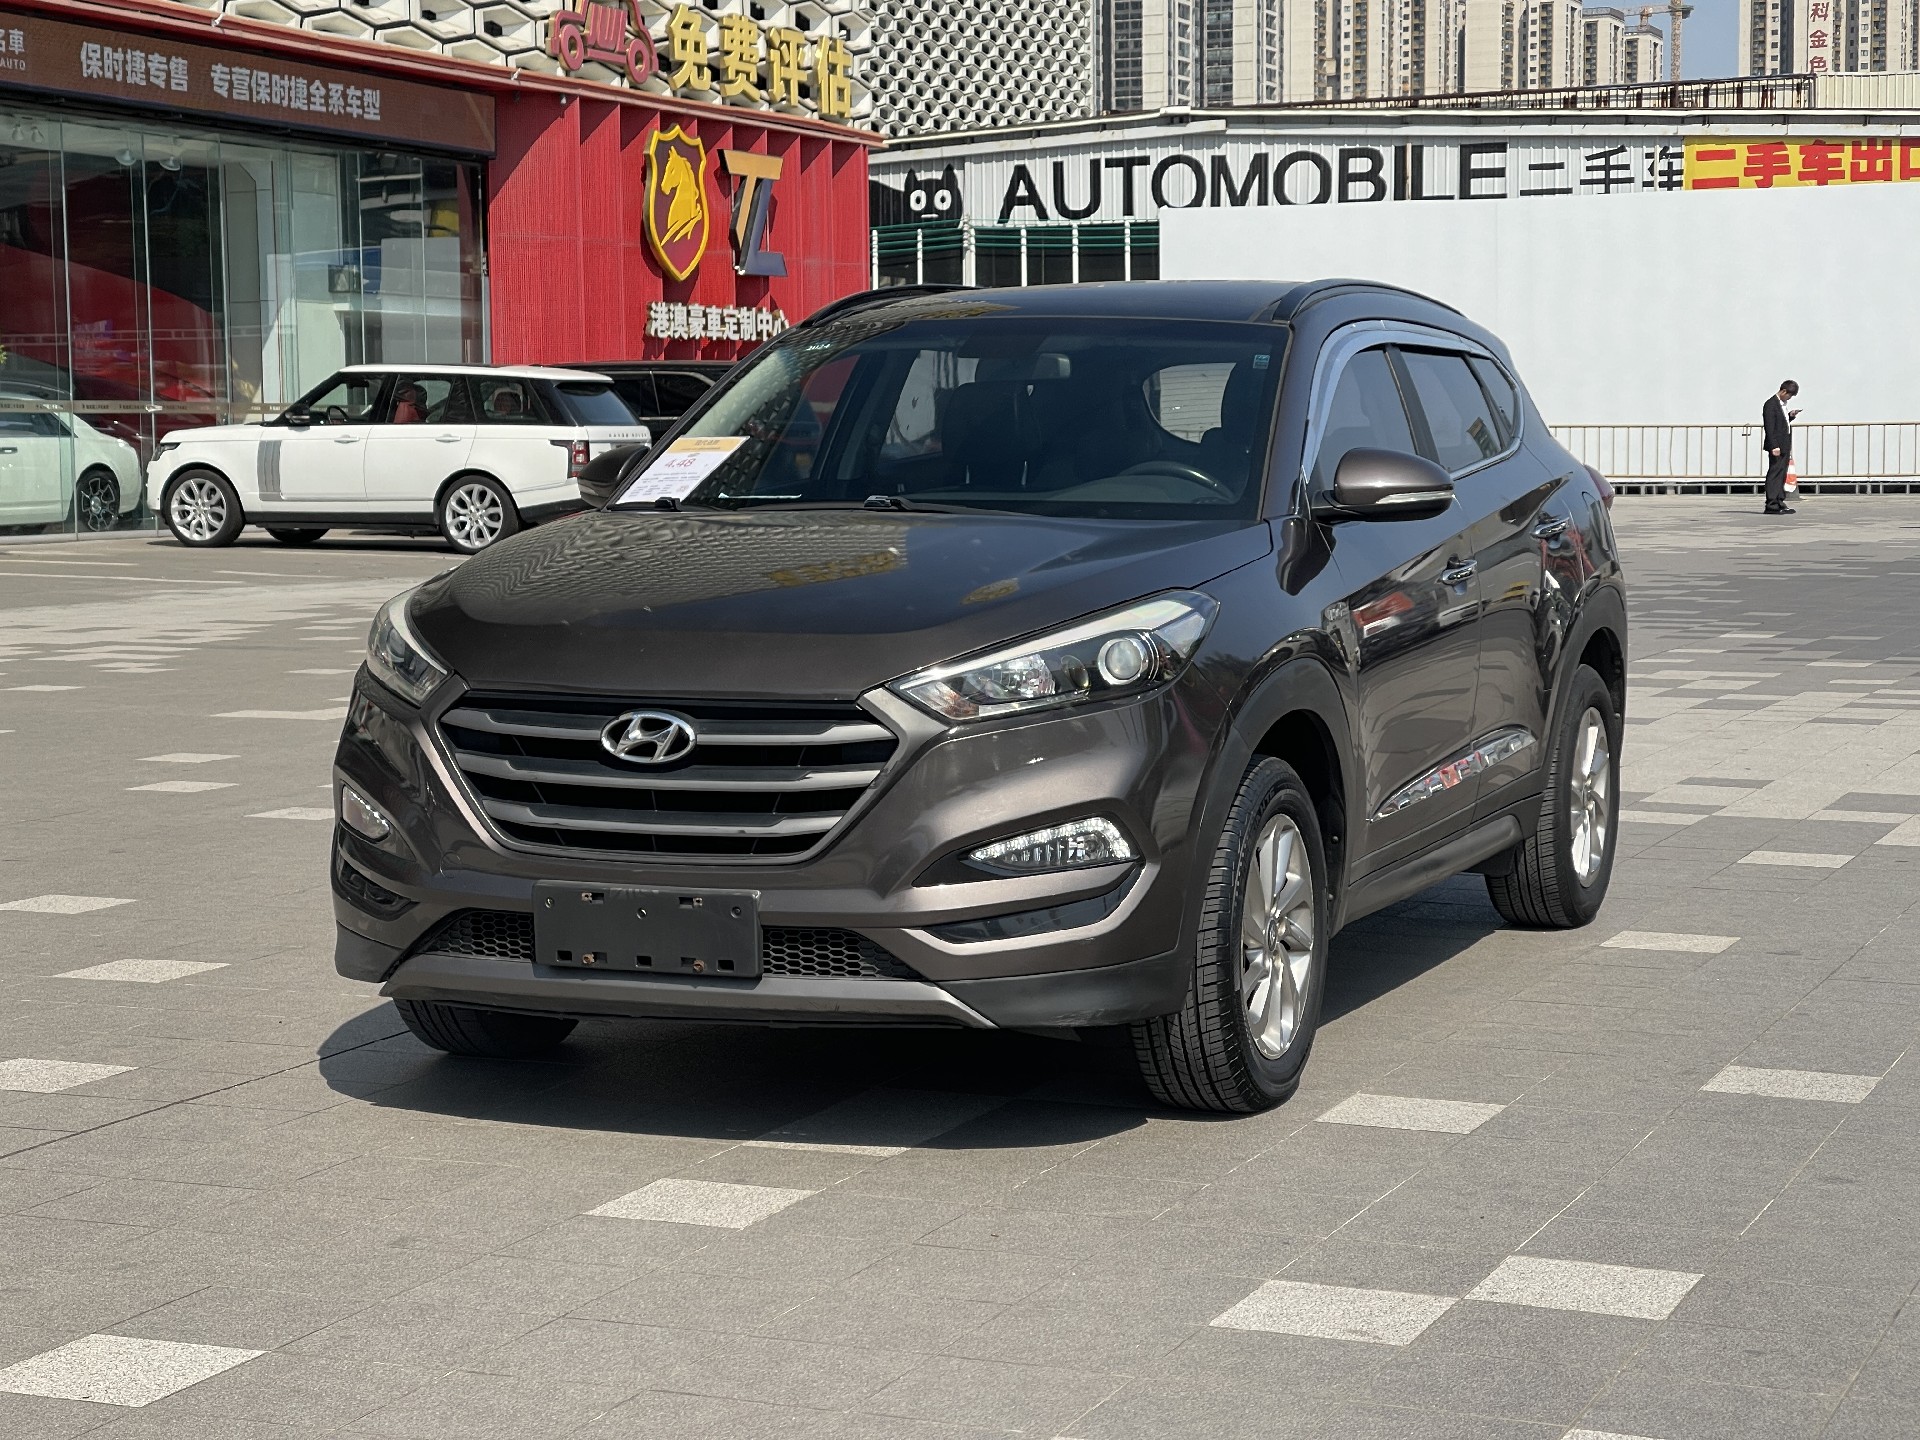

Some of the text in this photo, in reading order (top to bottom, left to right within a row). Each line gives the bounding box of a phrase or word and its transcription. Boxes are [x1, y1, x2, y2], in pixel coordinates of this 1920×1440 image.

[666, 2, 852, 119] 免费评估
[1809, 2, 1830, 73] 科金色
[80, 41, 381, 121] 保时捷专售 专营保时捷全系车型
[997, 141, 1508, 224] AUTOMOBILE
[1519, 144, 1684, 195] 二手车
